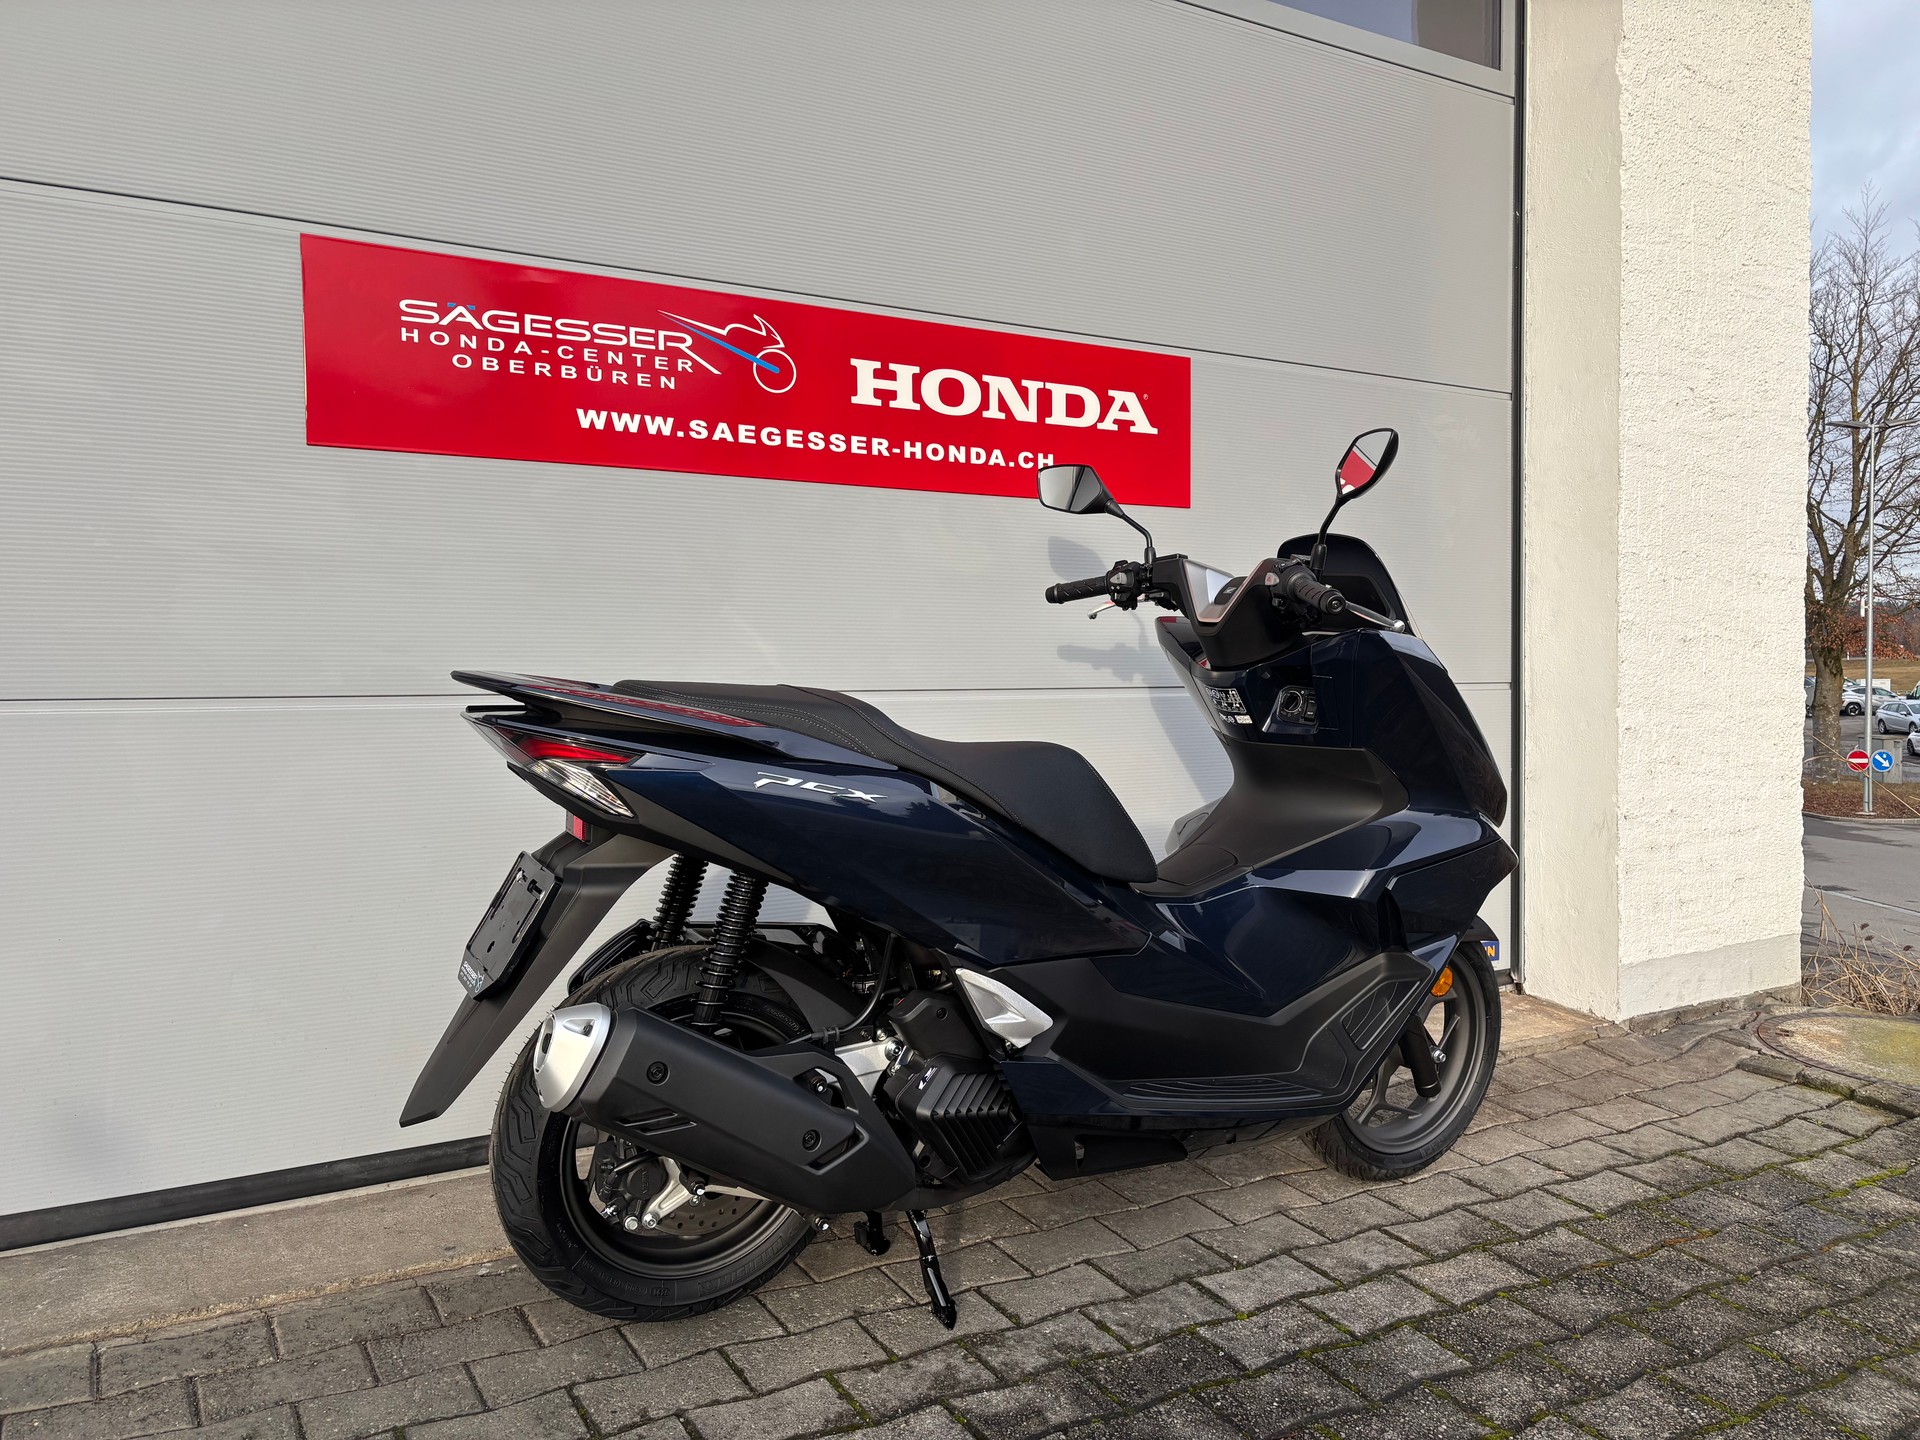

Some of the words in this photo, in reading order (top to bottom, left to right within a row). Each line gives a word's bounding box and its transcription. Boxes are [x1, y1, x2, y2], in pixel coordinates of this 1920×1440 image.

[399, 298, 722, 375] SÄGESSER
[400, 327, 696, 373] HONDA-CENTER
[452, 353, 676, 390] OBERBÜREN
[850, 357, 1159, 435] HONDA
[576, 408, 1054, 469] WWW.SAEGESSER-HONDA.CH
[753, 771, 888, 804] PCX
